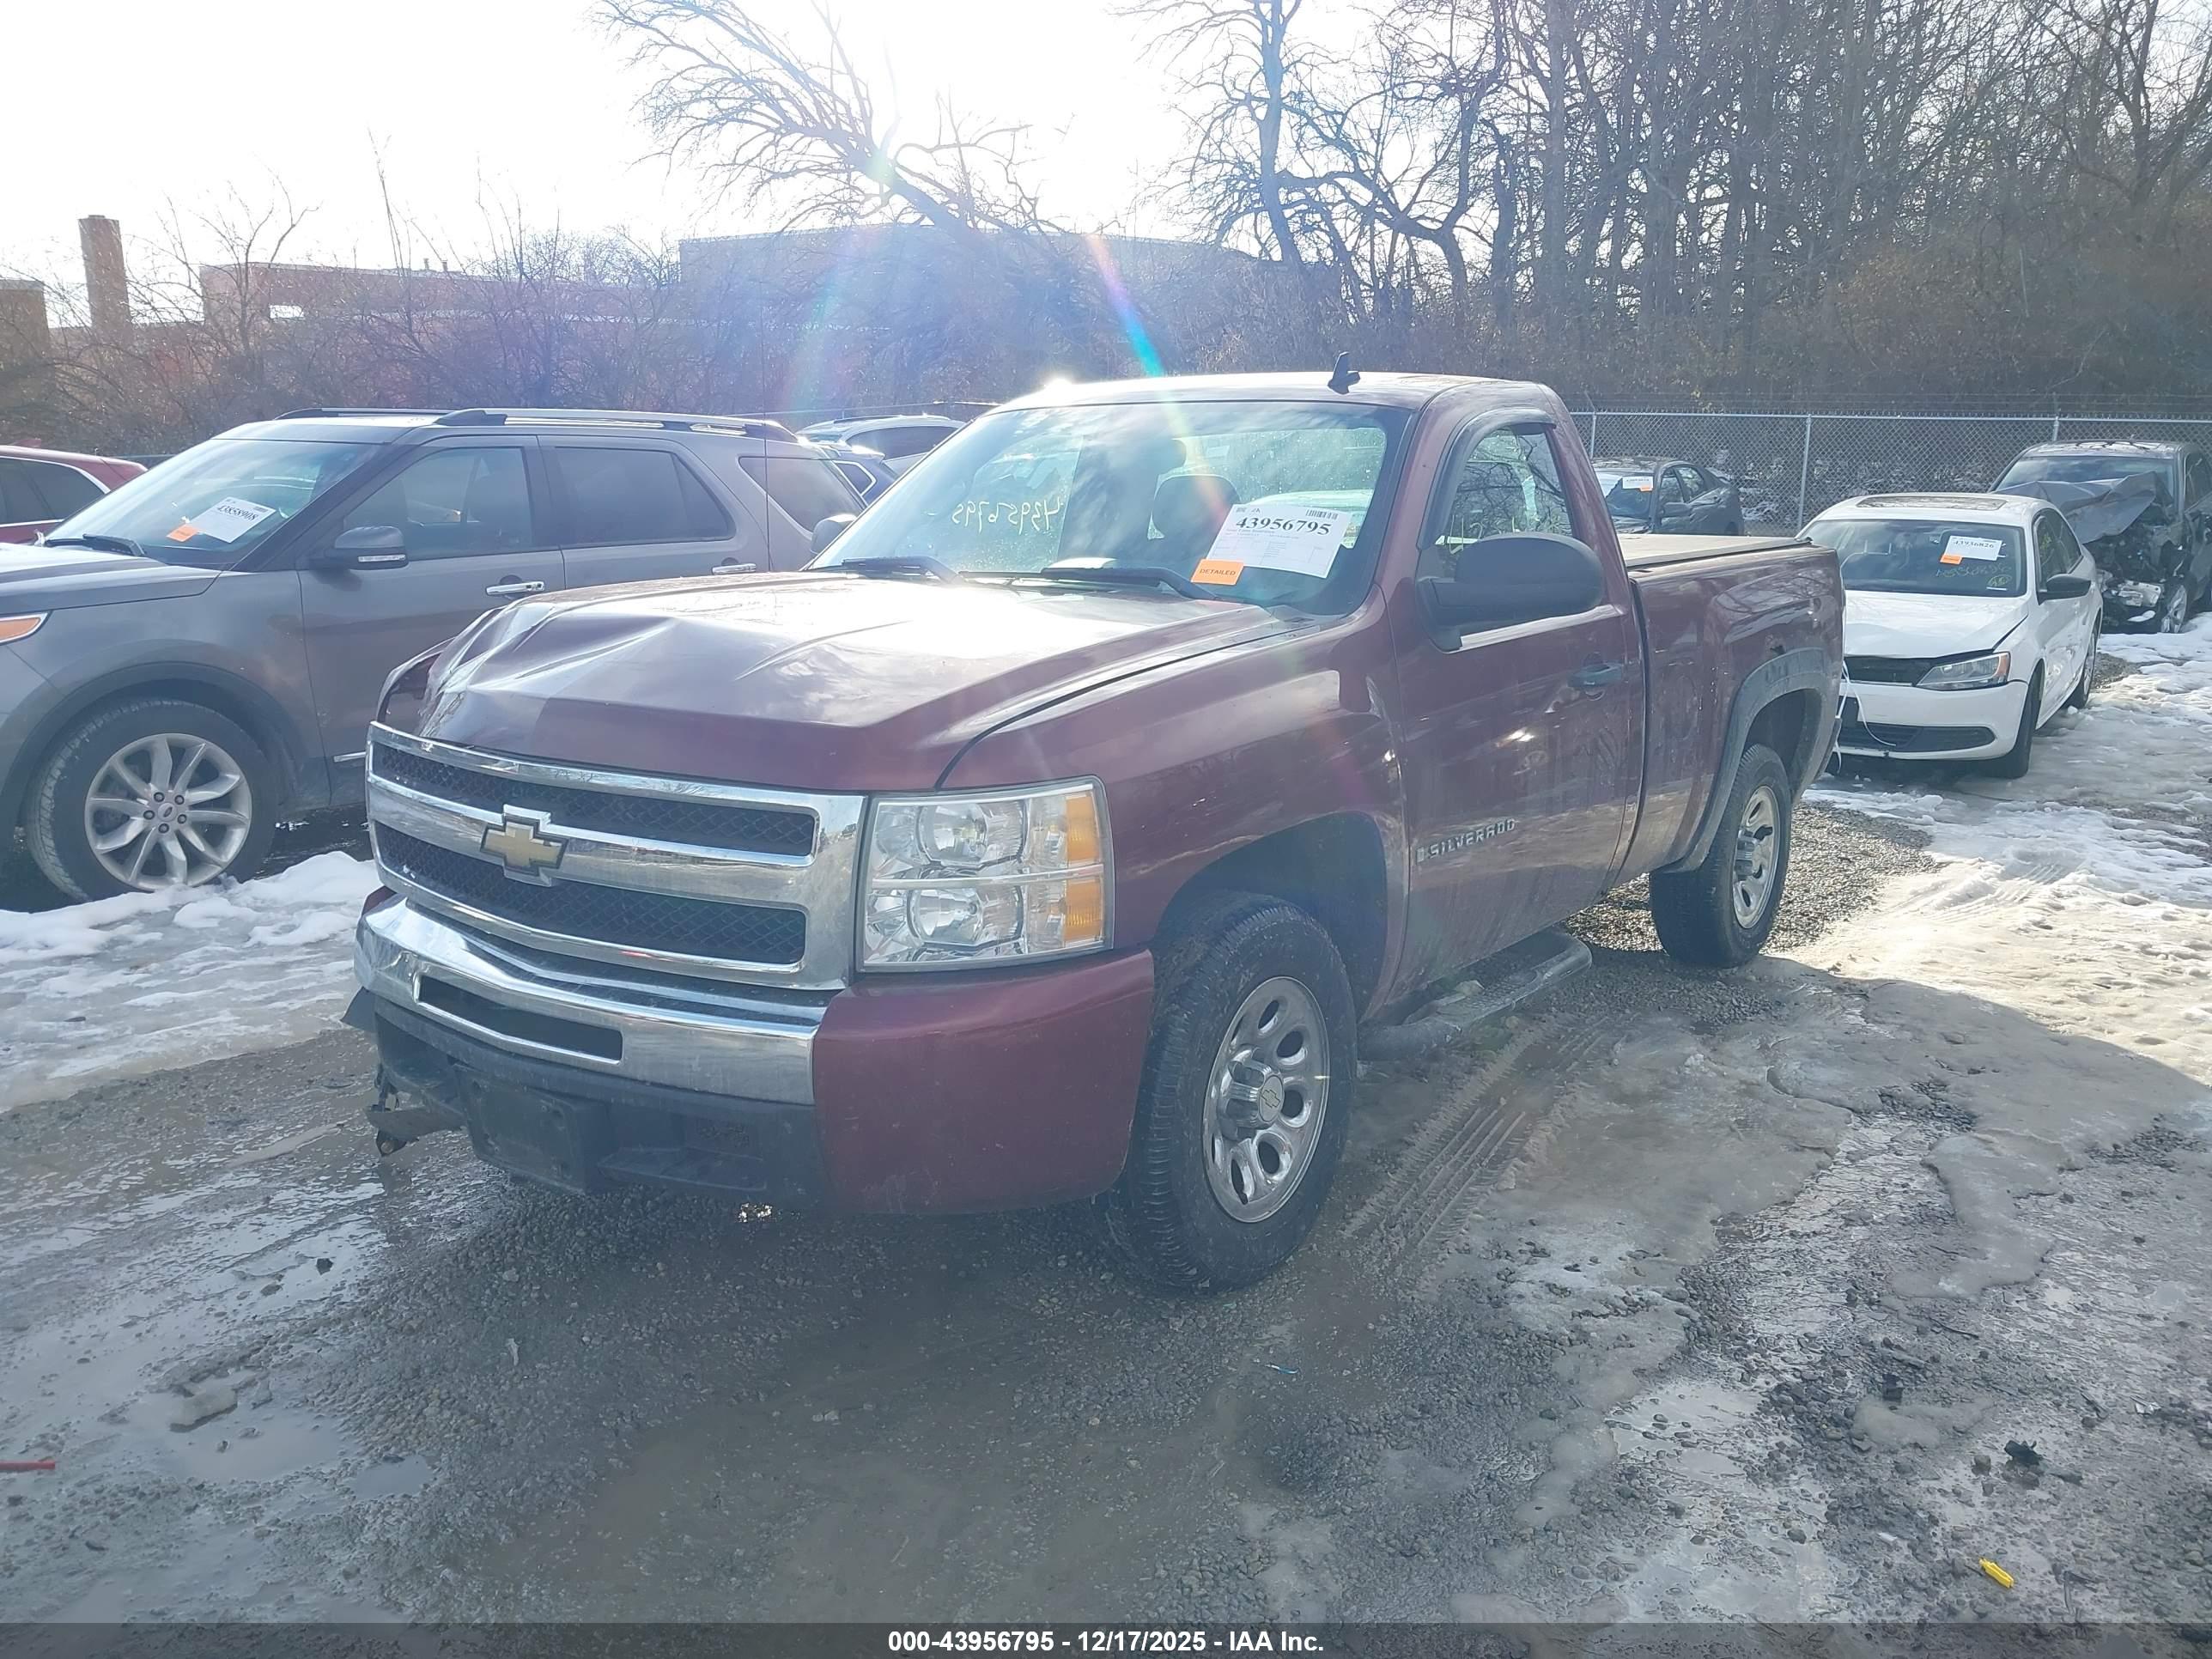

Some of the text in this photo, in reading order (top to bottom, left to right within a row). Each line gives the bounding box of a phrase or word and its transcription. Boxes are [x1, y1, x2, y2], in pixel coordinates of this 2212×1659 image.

[1235, 517, 1332, 536] 43956795
[1199, 568, 1237, 576] DETAILED
[1429, 817, 1516, 860] SILVERADO
